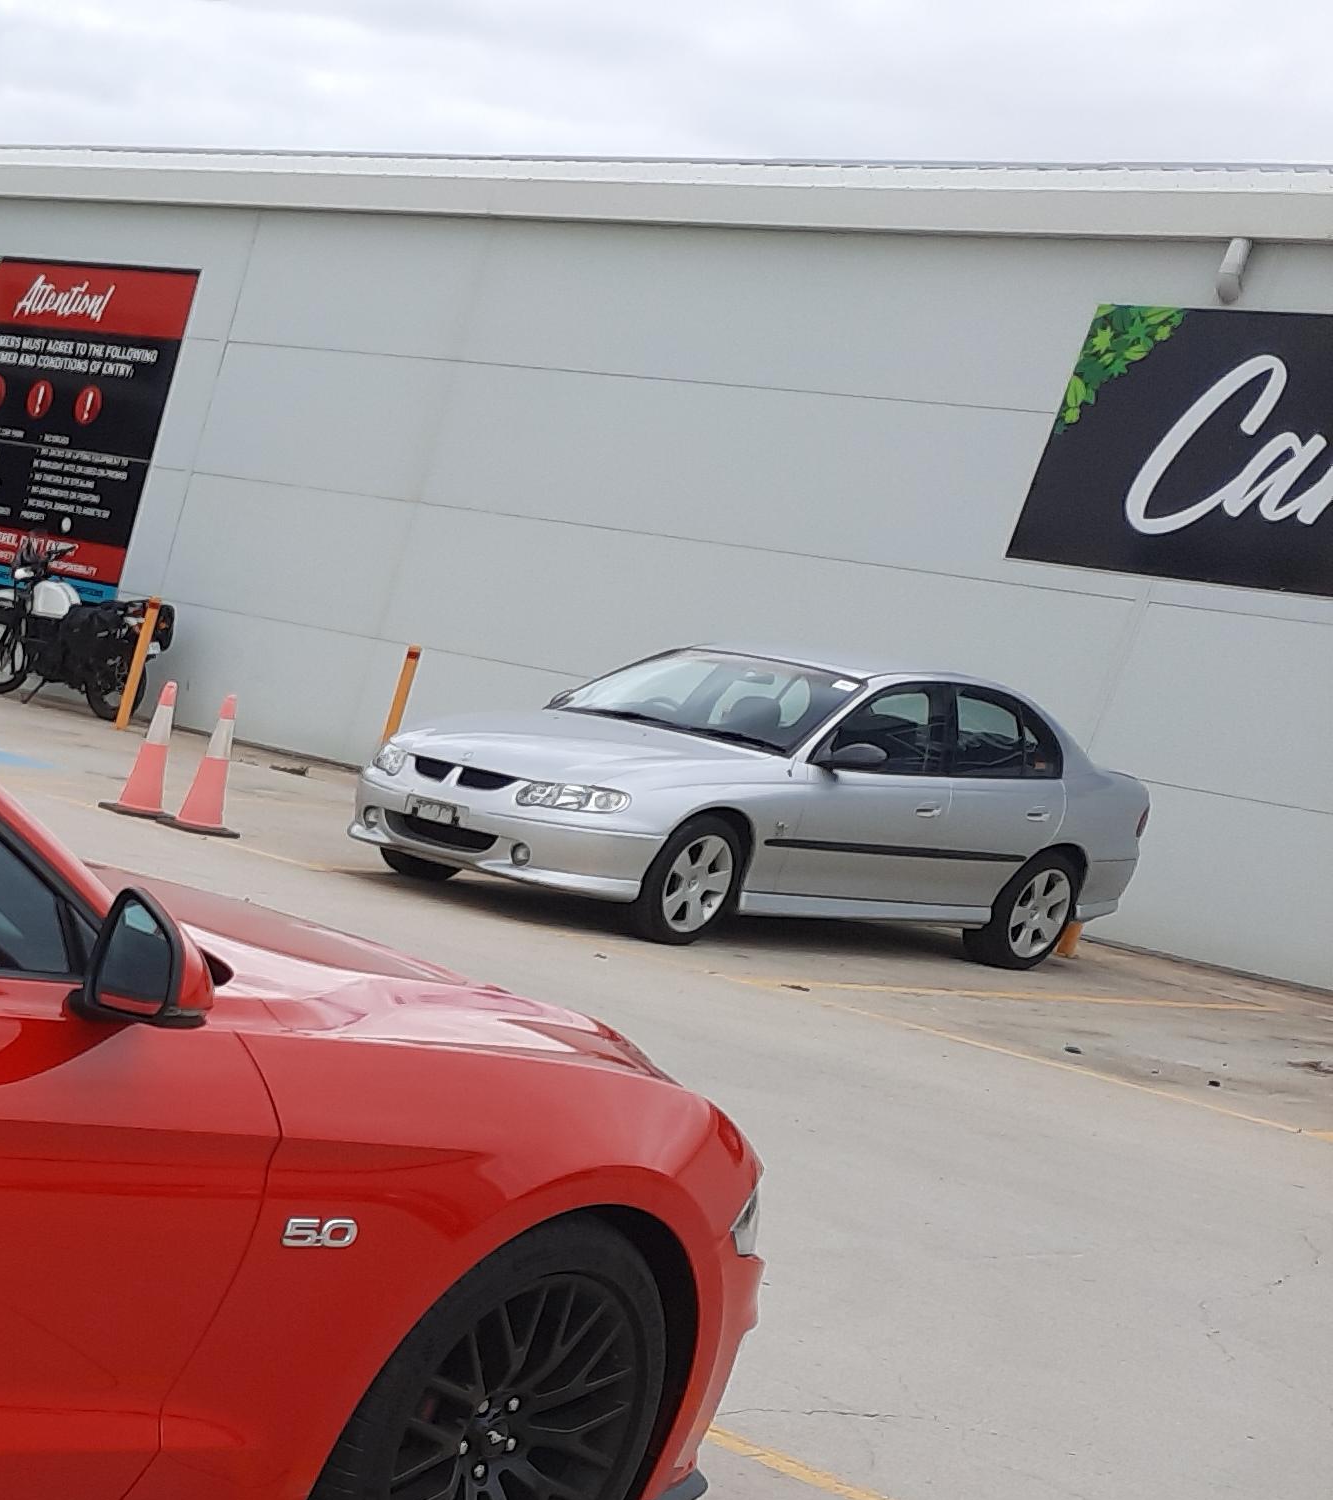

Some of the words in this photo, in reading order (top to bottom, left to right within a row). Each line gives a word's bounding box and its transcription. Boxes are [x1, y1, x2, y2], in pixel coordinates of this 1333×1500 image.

[13, 274, 115, 322] Attention!
[19, 354, 36, 367] AND
[37, 355, 88, 373] CONDITIONS
[22, 336, 46, 352] MUST
[47, 340, 74, 355] AGREE
[76, 343, 88, 356] TO
[105, 346, 158, 363] FOLLOWING
[281, 1216, 359, 1248] 5.0
